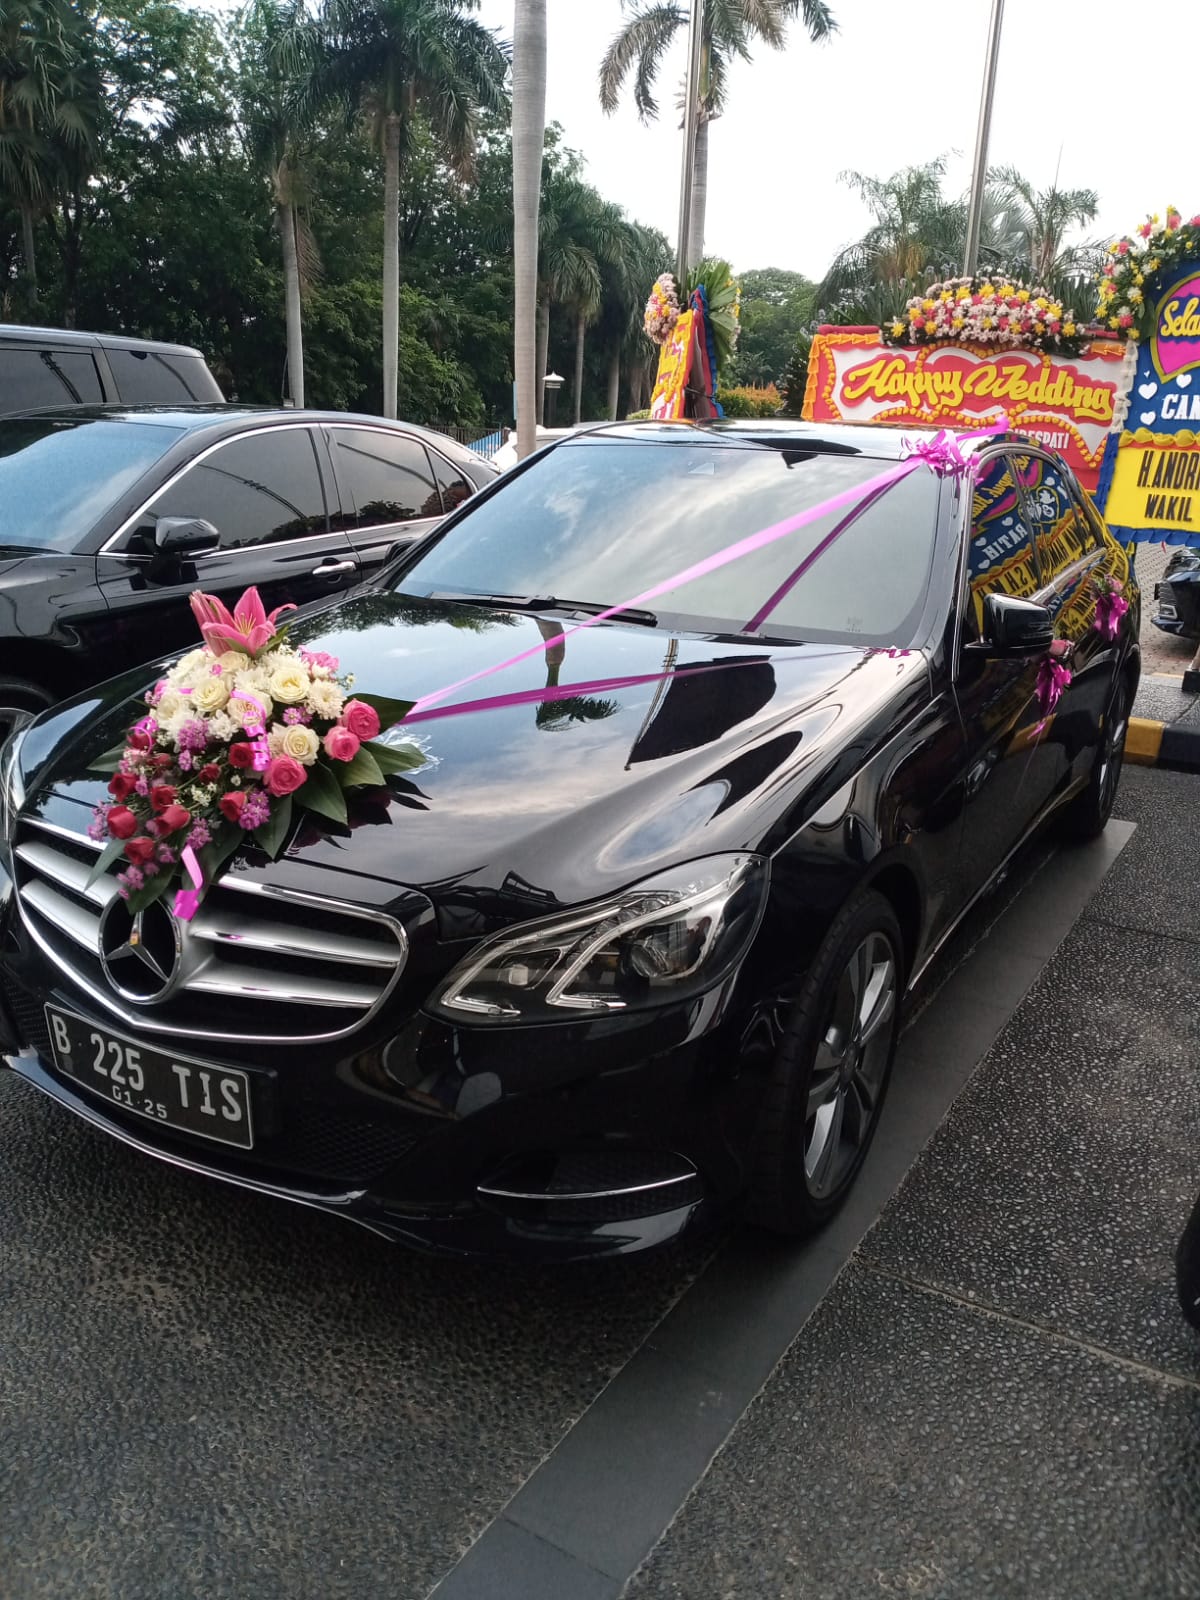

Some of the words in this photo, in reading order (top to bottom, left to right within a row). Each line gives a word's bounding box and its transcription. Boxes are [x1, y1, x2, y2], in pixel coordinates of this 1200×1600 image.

[843, 358, 965, 408] Happy
[964, 365, 1113, 421] Wedding
[1144, 494, 1193, 523] WAKIL
[51, 1014, 72, 1054] B
[90, 1033, 145, 1091] 225
[172, 1064, 242, 1122] TIS
